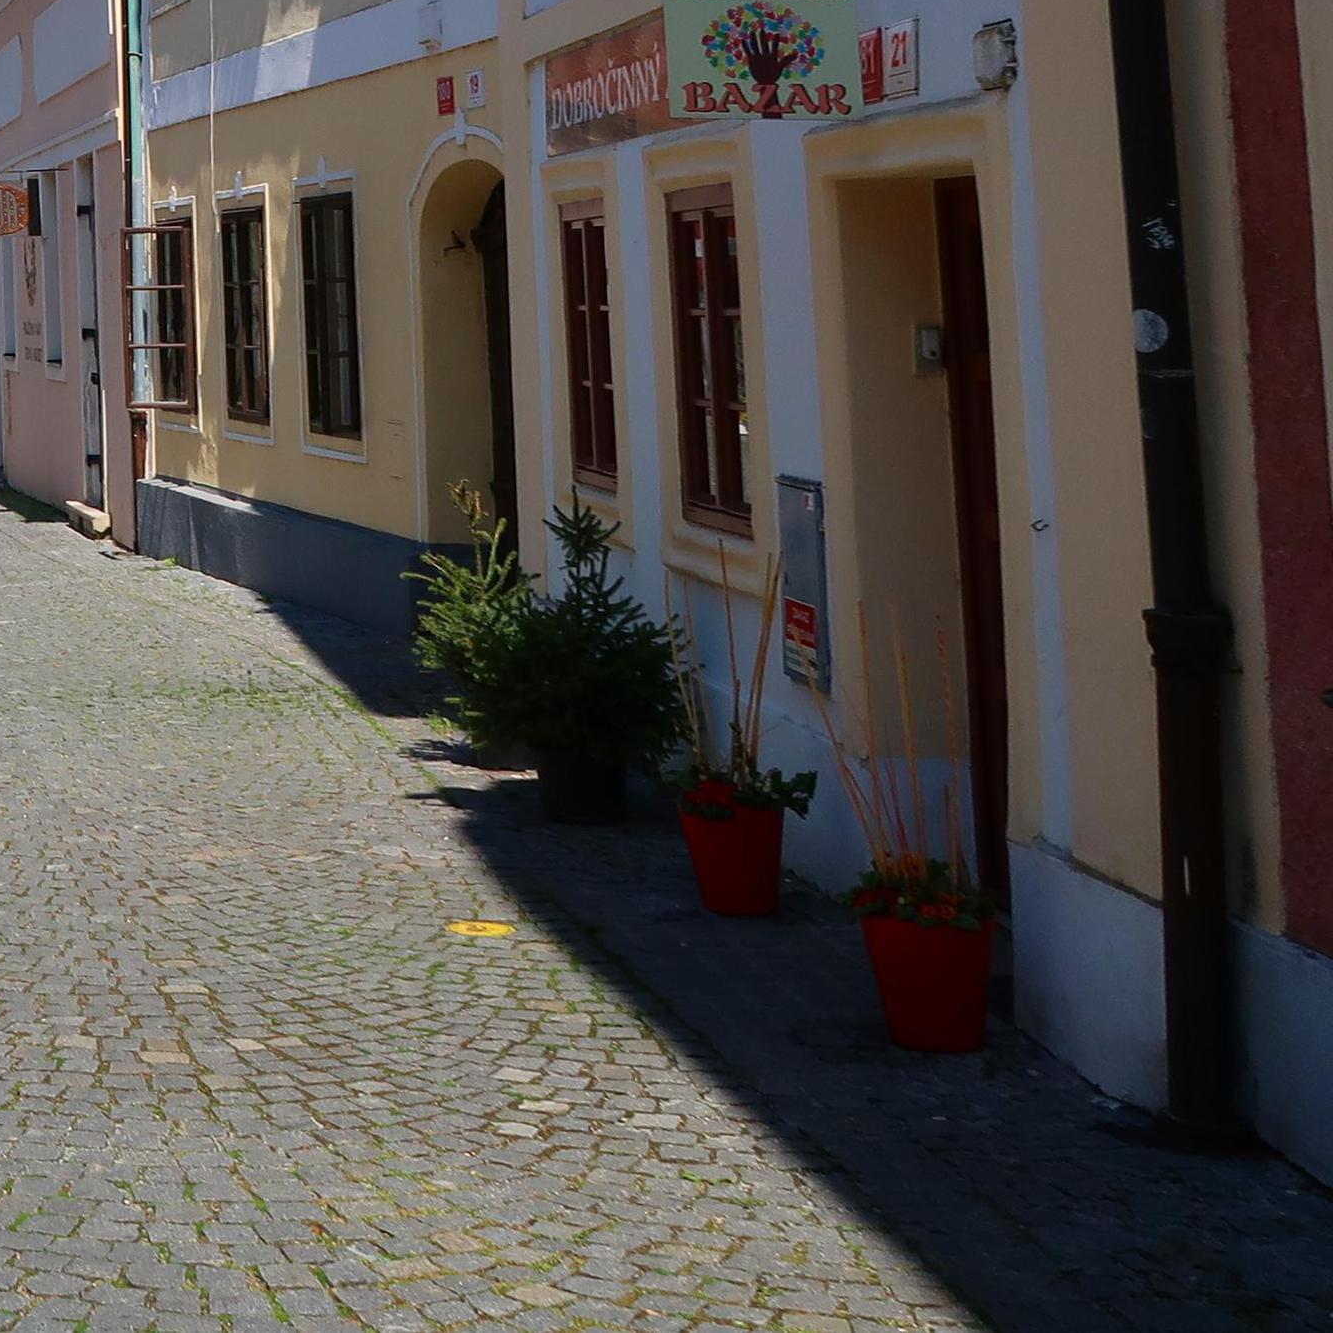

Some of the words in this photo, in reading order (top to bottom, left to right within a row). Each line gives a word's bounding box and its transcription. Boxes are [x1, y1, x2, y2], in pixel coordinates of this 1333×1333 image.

[892, 30, 906, 67] 21
[551, 41, 660, 130] DOBROČINNÝ
[683, 82, 852, 115] BAZAR
